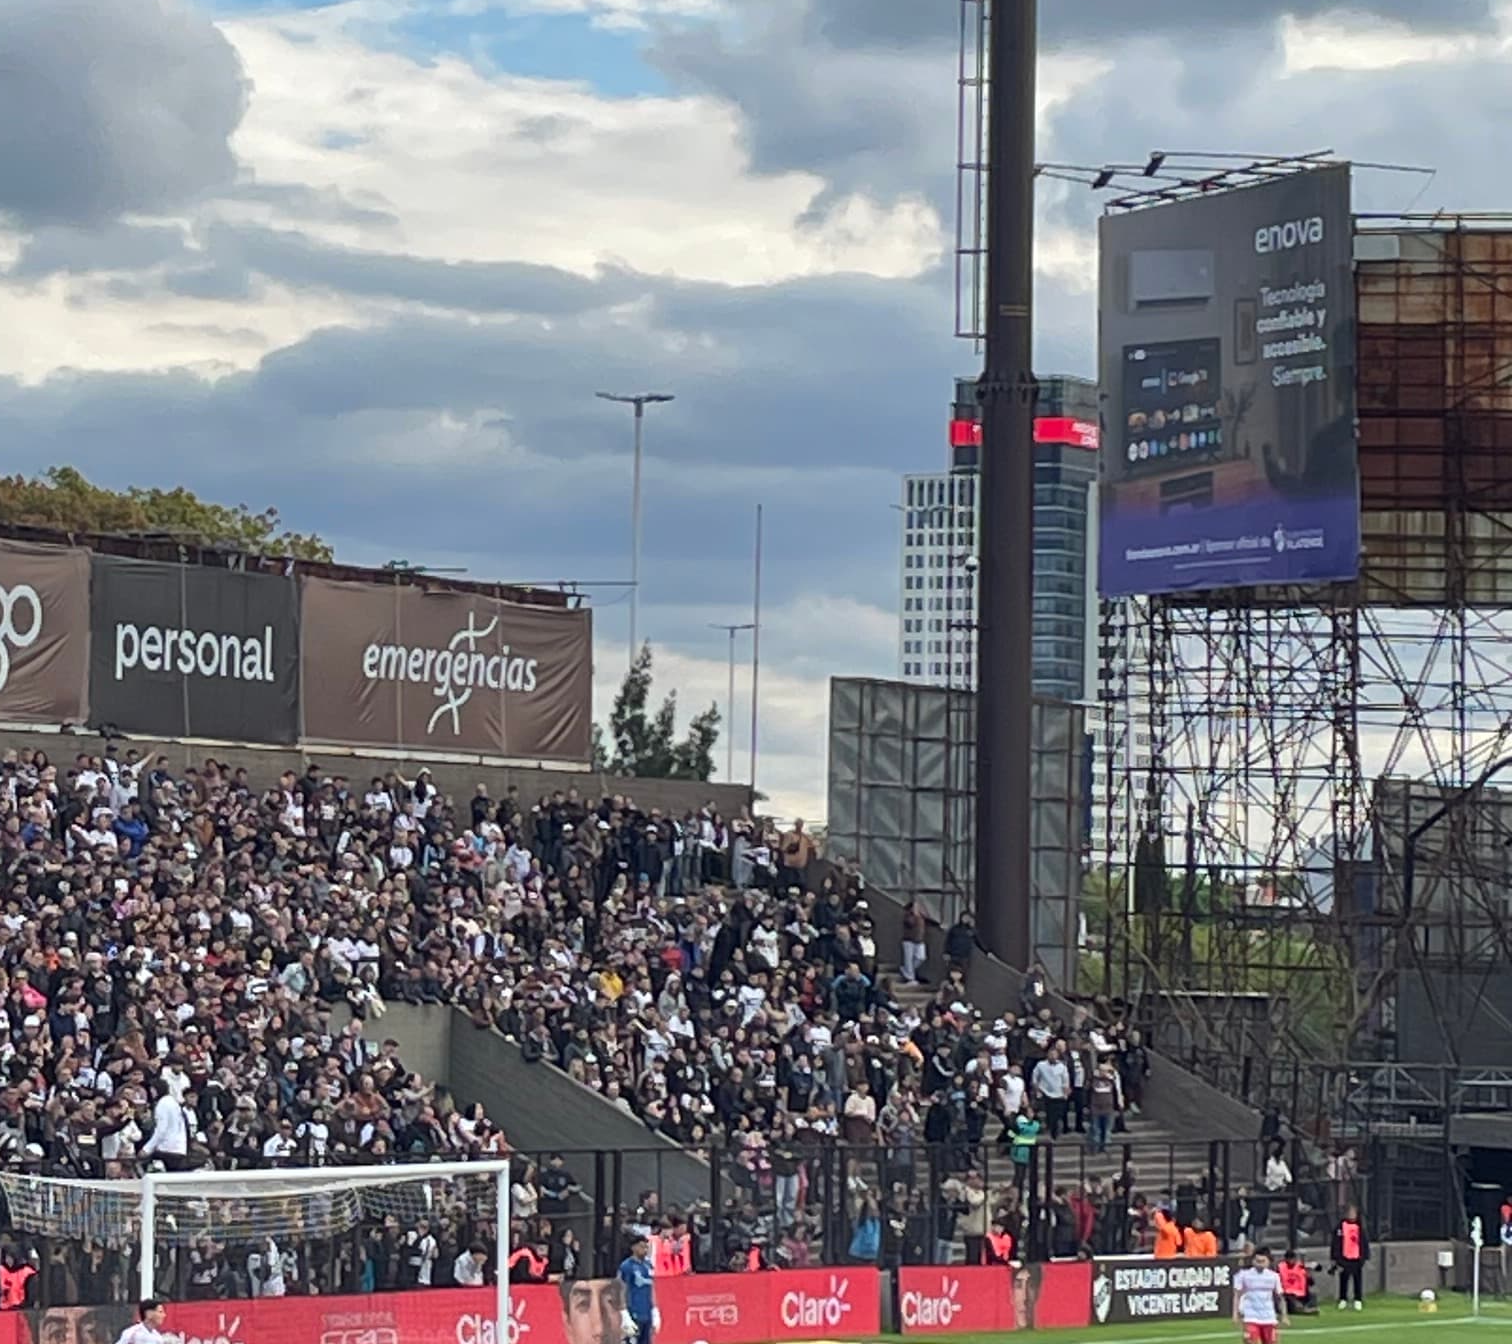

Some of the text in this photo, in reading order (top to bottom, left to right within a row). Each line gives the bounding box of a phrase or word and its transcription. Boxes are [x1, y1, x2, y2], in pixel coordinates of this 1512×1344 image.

[1254, 214, 1324, 254] enova
[114, 622, 276, 682] personal
[362, 640, 538, 697] emergencias
[1114, 1265, 1231, 1291] ESTADIO CIUDAD DE
[780, 1290, 843, 1328] Claro
[900, 1290, 955, 1327] Claro
[1127, 1288, 1220, 1316] VICENTE LÓPEZ
